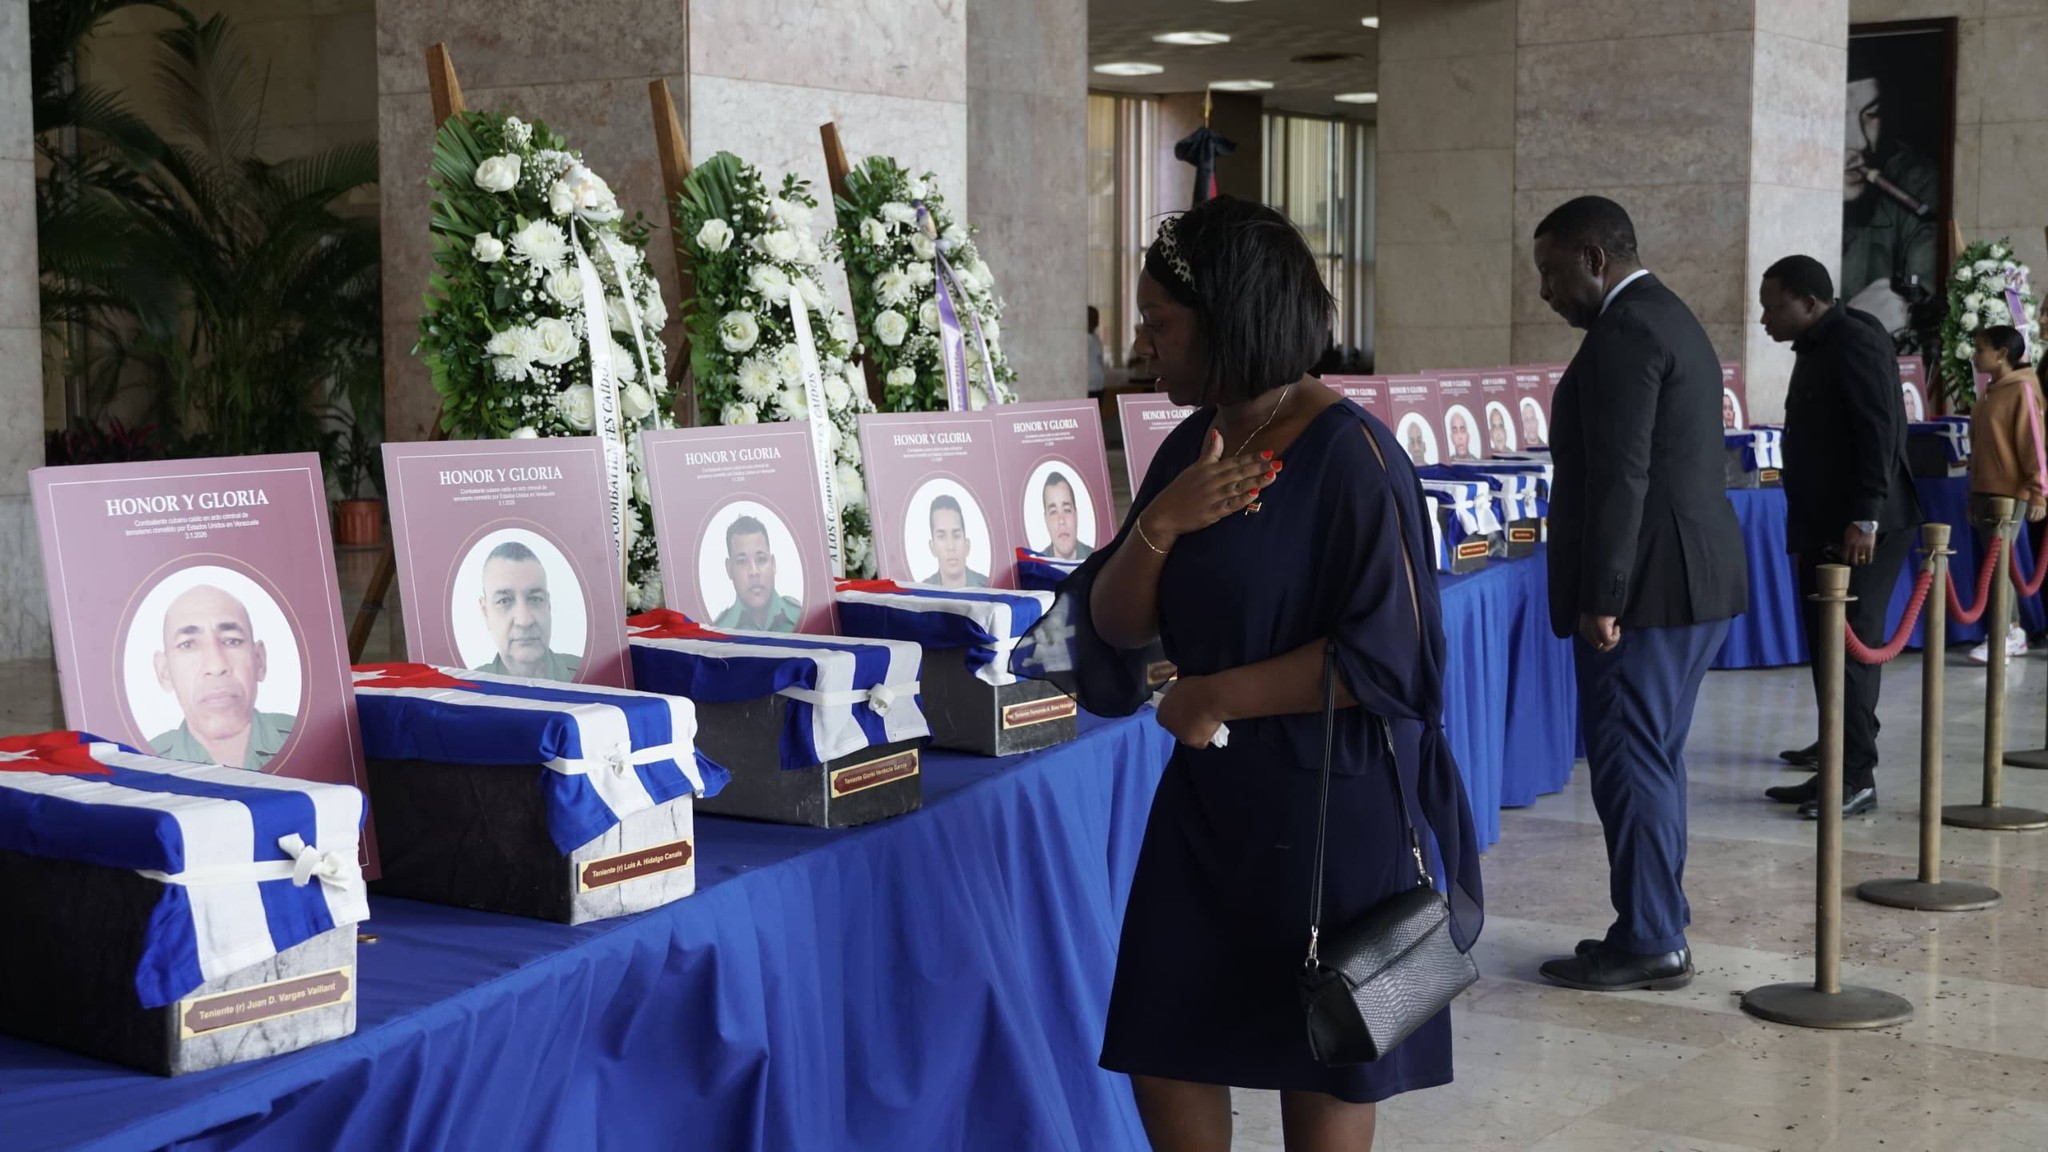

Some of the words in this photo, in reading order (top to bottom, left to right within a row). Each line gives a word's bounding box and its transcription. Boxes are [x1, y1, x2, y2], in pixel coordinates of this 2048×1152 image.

[1013, 421, 1043, 433] HONOR
[1043, 421, 1048, 431] Y
[1049, 419, 1079, 430] GLORIA
[893, 433, 929, 446] HONOR
[929, 433, 936, 444] Y
[937, 432, 972, 443] GLORIA
[685, 450, 728, 465] HONOR
[729, 450, 737, 462] Y
[739, 447, 781, 461] GLORIA
[439, 469, 495, 485] HONOR
[496, 468, 506, 482] Y
[509, 466, 563, 481] GLORIA
[105, 495, 180, 516] HONOR
[182, 494, 195, 511] Y
[199, 489, 269, 509] GLORIA
[828, 524, 838, 550] LOS
[829, 553, 838, 563] A
[592, 866, 616, 878] Teniente
[616, 864, 624, 874] (r)
[624, 861, 636, 870] Luis
[643, 855, 664, 866] Hidalgo
[199, 1005, 234, 1020] Teniente
[235, 1002, 246, 1015] (r)
[246, 998, 267, 1010] Juan
[268, 996, 278, 1005] D.
[278, 991, 306, 1004] Vargas
[306, 980, 336, 996] Vaillant
